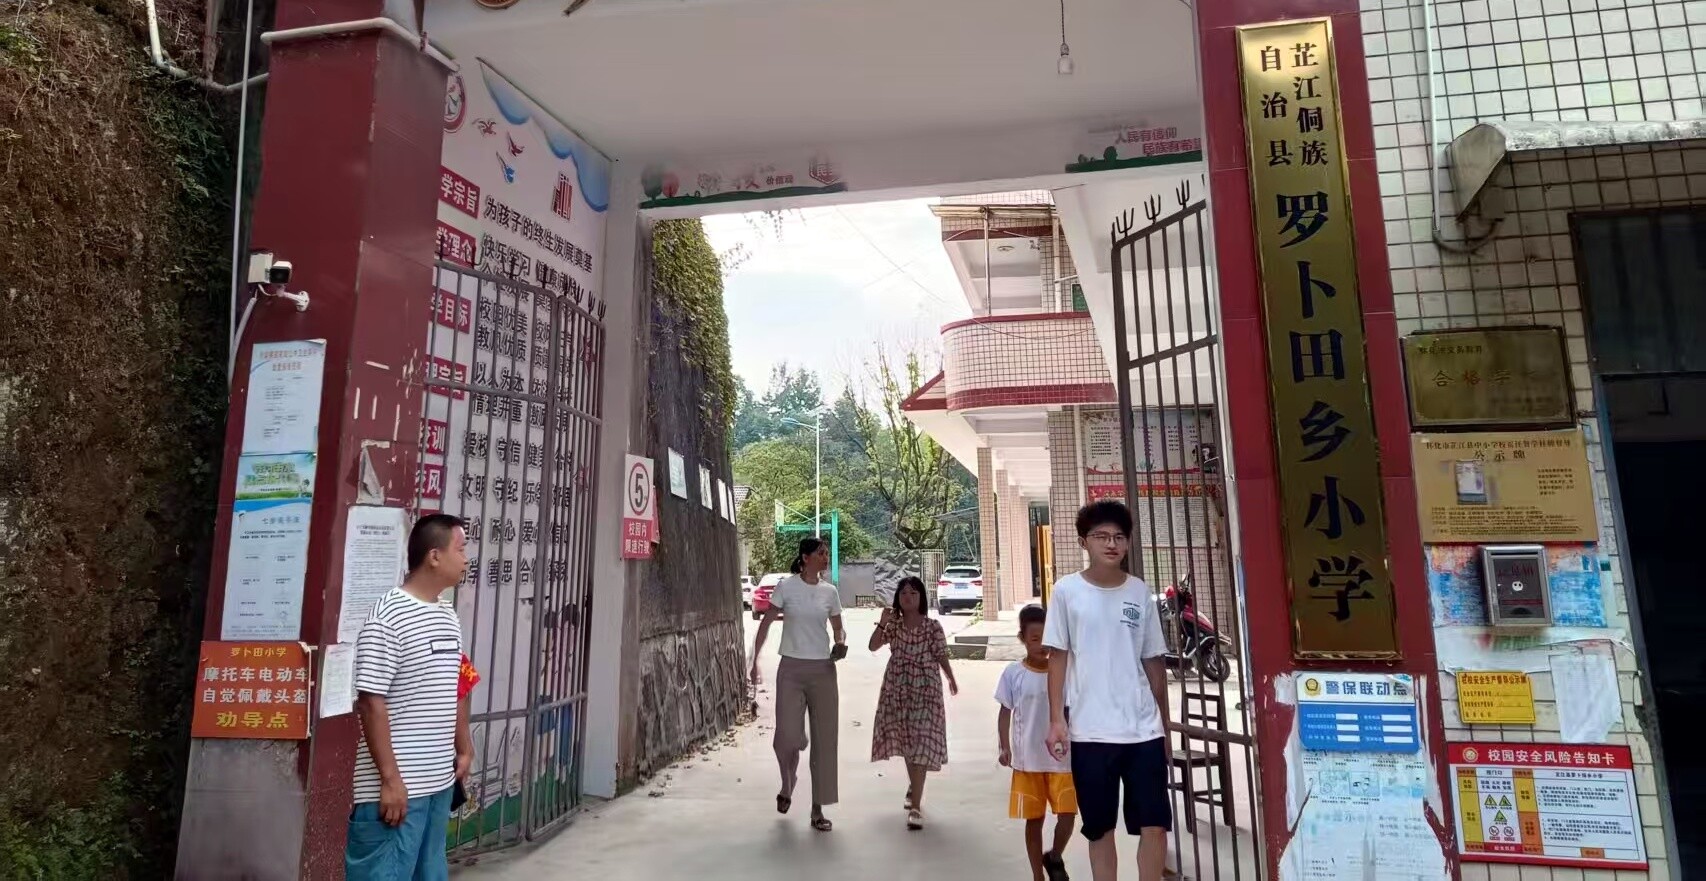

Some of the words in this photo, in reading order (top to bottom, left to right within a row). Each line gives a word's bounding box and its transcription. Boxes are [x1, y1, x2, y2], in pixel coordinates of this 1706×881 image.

[1261, 45, 1293, 166] 自治县
[1289, 42, 1329, 167] 芷江侗族
[1277, 193, 1374, 622] 罗卜田乡小学
[1474, 450, 1526, 463] 公示牌
[635, 472, 644, 508] 5
[231, 647, 287, 658] 罗卜田小学
[203, 666, 308, 683] 摩托车电动车
[203, 687, 307, 704] 自觉佩戴头盔
[1325, 680, 1408, 697] 警保联动点
[216, 711, 289, 728] 劝导点
[1488, 749, 1616, 765] 校园安全风险告知卡
